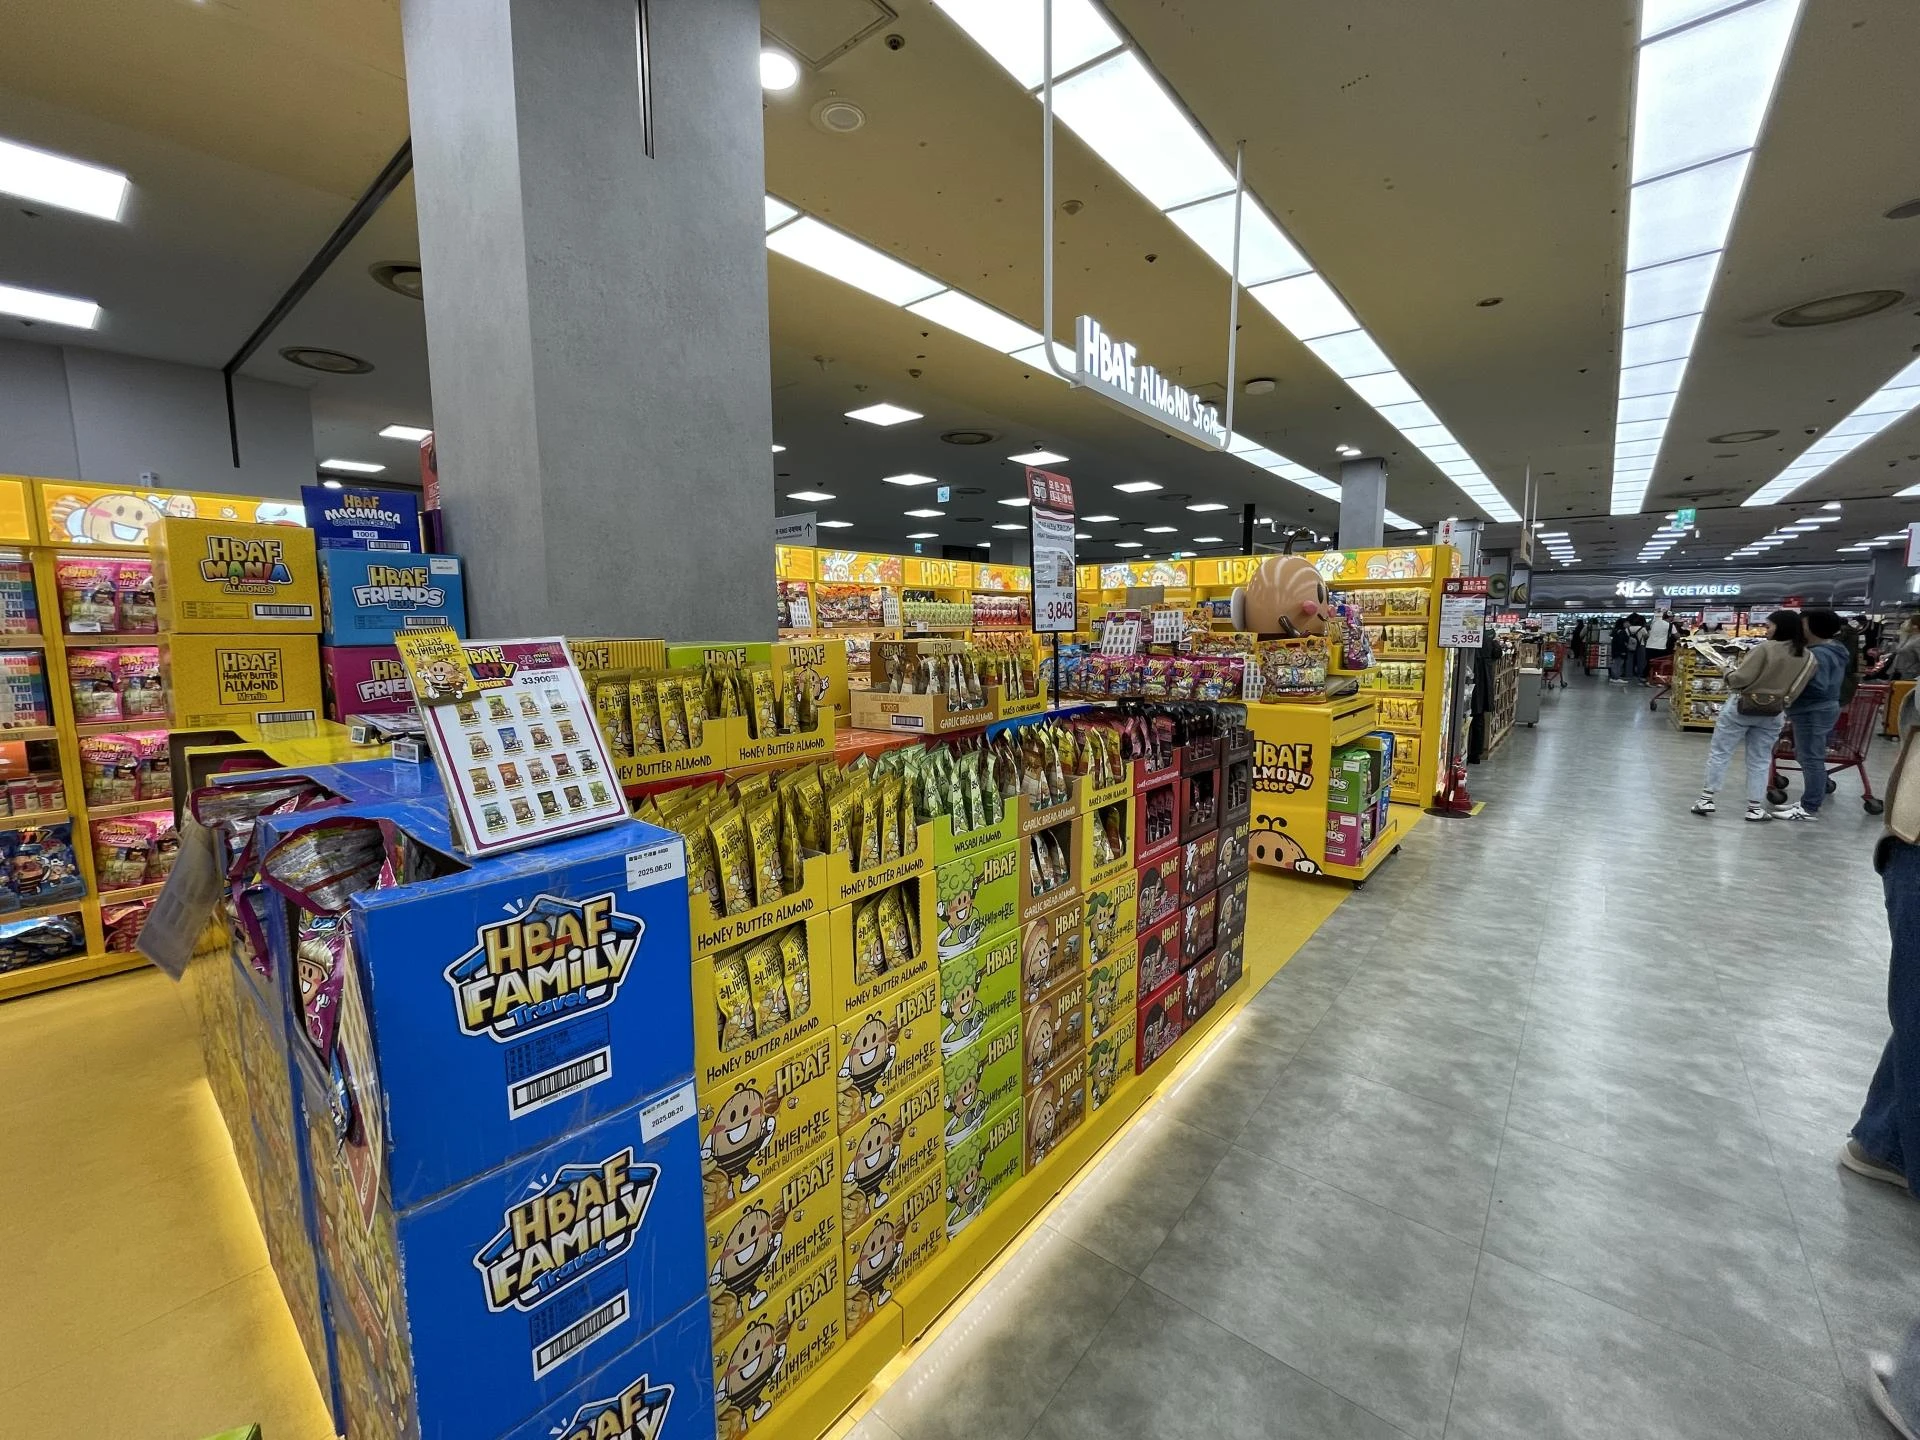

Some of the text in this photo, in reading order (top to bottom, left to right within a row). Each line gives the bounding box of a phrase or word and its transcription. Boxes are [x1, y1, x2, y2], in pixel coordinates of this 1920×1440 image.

[1083, 315, 1136, 395] HBAF
[1140, 365, 1191, 422] ALMOND
[343, 493, 379, 508] HBAF
[324, 508, 401, 522] MACAMACA
[210, 537, 282, 565] HBAF
[206, 562, 288, 582] MANIA
[370, 567, 426, 587] HBAF
[920, 561, 957, 586] HBAF
[1217, 560, 1258, 586] HBA
[223, 584, 275, 597] ALMONDS
[354, 586, 444, 606] FRIENDS
[1615, 582, 1741, 597] 채소 VEGETABLES
[5, 610, 24, 618] SAT
[1047, 601, 1073, 621] 3,843
[1451, 635, 1480, 644] 5,394
[4, 657, 28, 667] MON
[222, 650, 274, 673] HBAF
[789, 645, 826, 667] HBAF
[6, 676, 30, 684] WED
[250, 672, 278, 681] BUTTER
[372, 660, 407, 682] HB
[10, 685, 31, 694] THU
[224, 681, 279, 694] ALMOND
[238, 693, 267, 704] Mania
[358, 680, 407, 703] FRIE
[14, 703, 34, 712] SAT
[14, 711, 36, 721] SUN
[940, 715, 960, 729] GARLIC
[767, 742, 796, 758] BUTTER
[797, 737, 826, 753] ALMOND
[614, 754, 713, 787] NEY BUTTER ALMOND
[1252, 766, 1313, 788] LMOND
[1255, 781, 1295, 793] store
[954, 838, 978, 855] WASABI
[1200, 837, 1216, 860] HBAF
[638, 862, 673, 878] 2025.06.20
[867, 869, 896, 892] BUTTER
[897, 858, 925, 879] ALMOND
[983, 851, 1017, 886] HBAF
[1161, 855, 1179, 880] HBAF
[1113, 880, 1136, 908] HBAF
[736, 912, 774, 939] BUTTER
[776, 898, 815, 925] ALMOND
[1055, 906, 1082, 937] HBAF
[484, 899, 611, 975] HBAF
[1162, 921, 1179, 950] HBAF
[986, 938, 1017, 980] HBAF
[1115, 949, 1136, 981] HBAF
[873, 975, 899, 998] BUTTER
[900, 960, 928, 985] ALMOND
[506, 986, 587, 1029] Travel
[895, 983, 937, 1029] HBAF
[1058, 983, 1084, 1018] HBAF
[1164, 985, 1182, 1013] HBAF
[745, 1036, 782, 1065] BUTTER
[783, 1015, 820, 1043] ALMOND
[988, 1024, 1019, 1064] HBAF
[1115, 1017, 1136, 1050] HBAF
[774, 1043, 832, 1098] HBAF
[882, 1041, 937, 1087] 허니버터아몬드
[1060, 1059, 1084, 1097] HBAF
[652, 1104, 684, 1128] 2025.06.20
[900, 1080, 941, 1128] HBAF
[757, 1108, 832, 1166] 허니버터아몬드
[989, 1108, 1020, 1152] HBAF
[761, 1131, 827, 1181] HONEY BUTTER ALMOND
[781, 1154, 836, 1214] HBAF
[510, 1152, 631, 1250] HBAF
[903, 1173, 942, 1226] HBAF
[764, 1215, 836, 1283] 허니버터아몬드
[532, 1240, 609, 1293] Travel
[789, 1255, 811, 1277] BUTTER
[786, 1262, 838, 1325] HBAF
[768, 1319, 839, 1393] 허니버터아몬드
